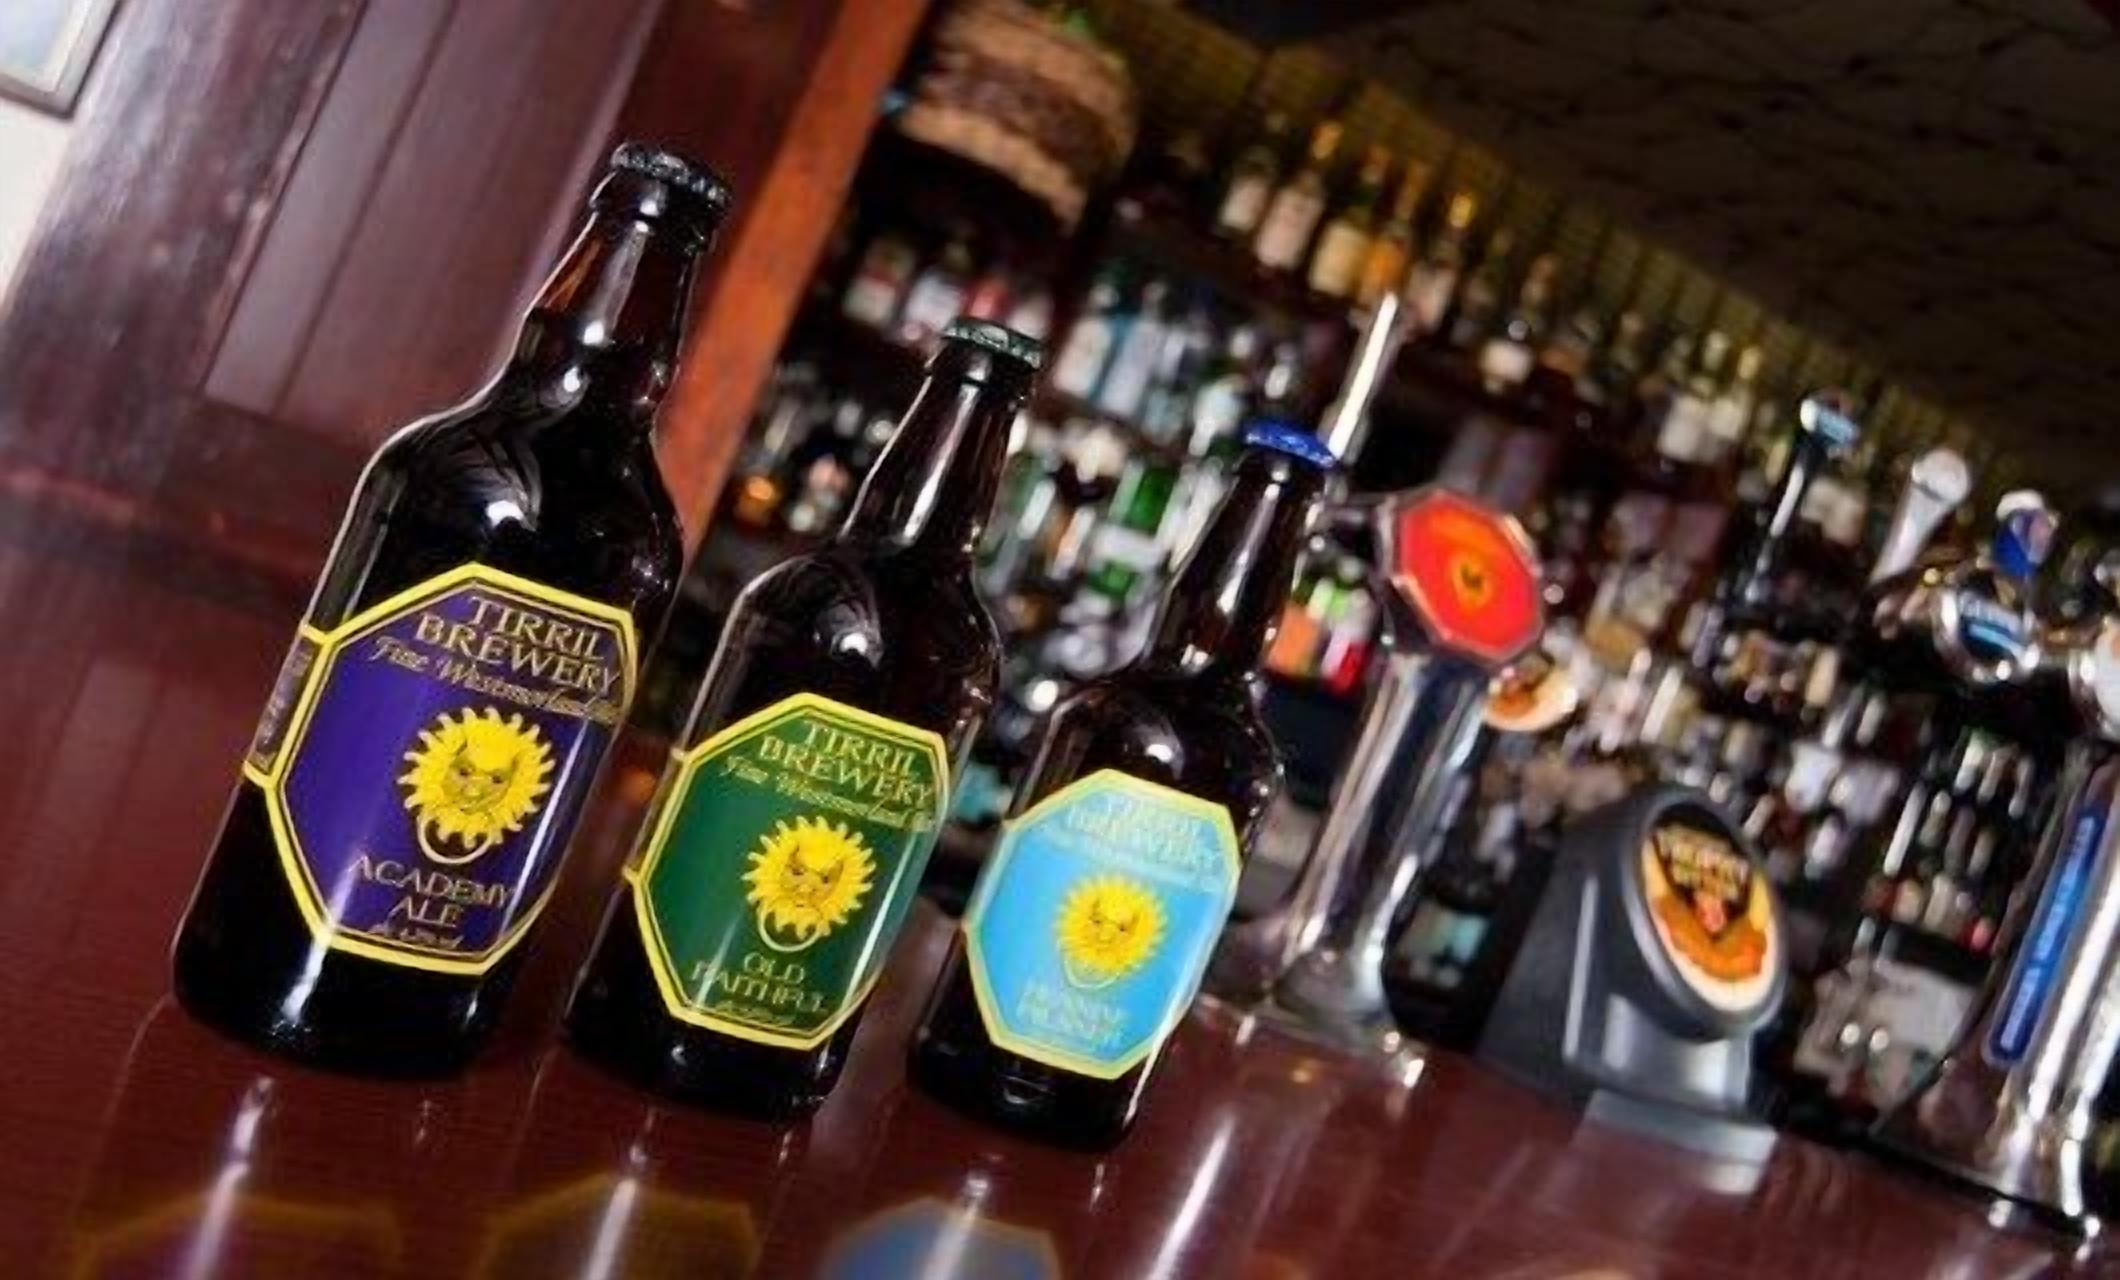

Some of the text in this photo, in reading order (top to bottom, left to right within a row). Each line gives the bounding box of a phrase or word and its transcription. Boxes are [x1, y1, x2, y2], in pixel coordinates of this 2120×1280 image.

[415, 611, 620, 696] BREWERY
[470, 595, 604, 661] TIRRIL
[759, 734, 934, 805] BREWERY
[803, 720, 921, 778] TIRRIL
[345, 854, 518, 907] ACADEMY
[386, 896, 465, 928] ALE
[743, 951, 805, 985] OLD
